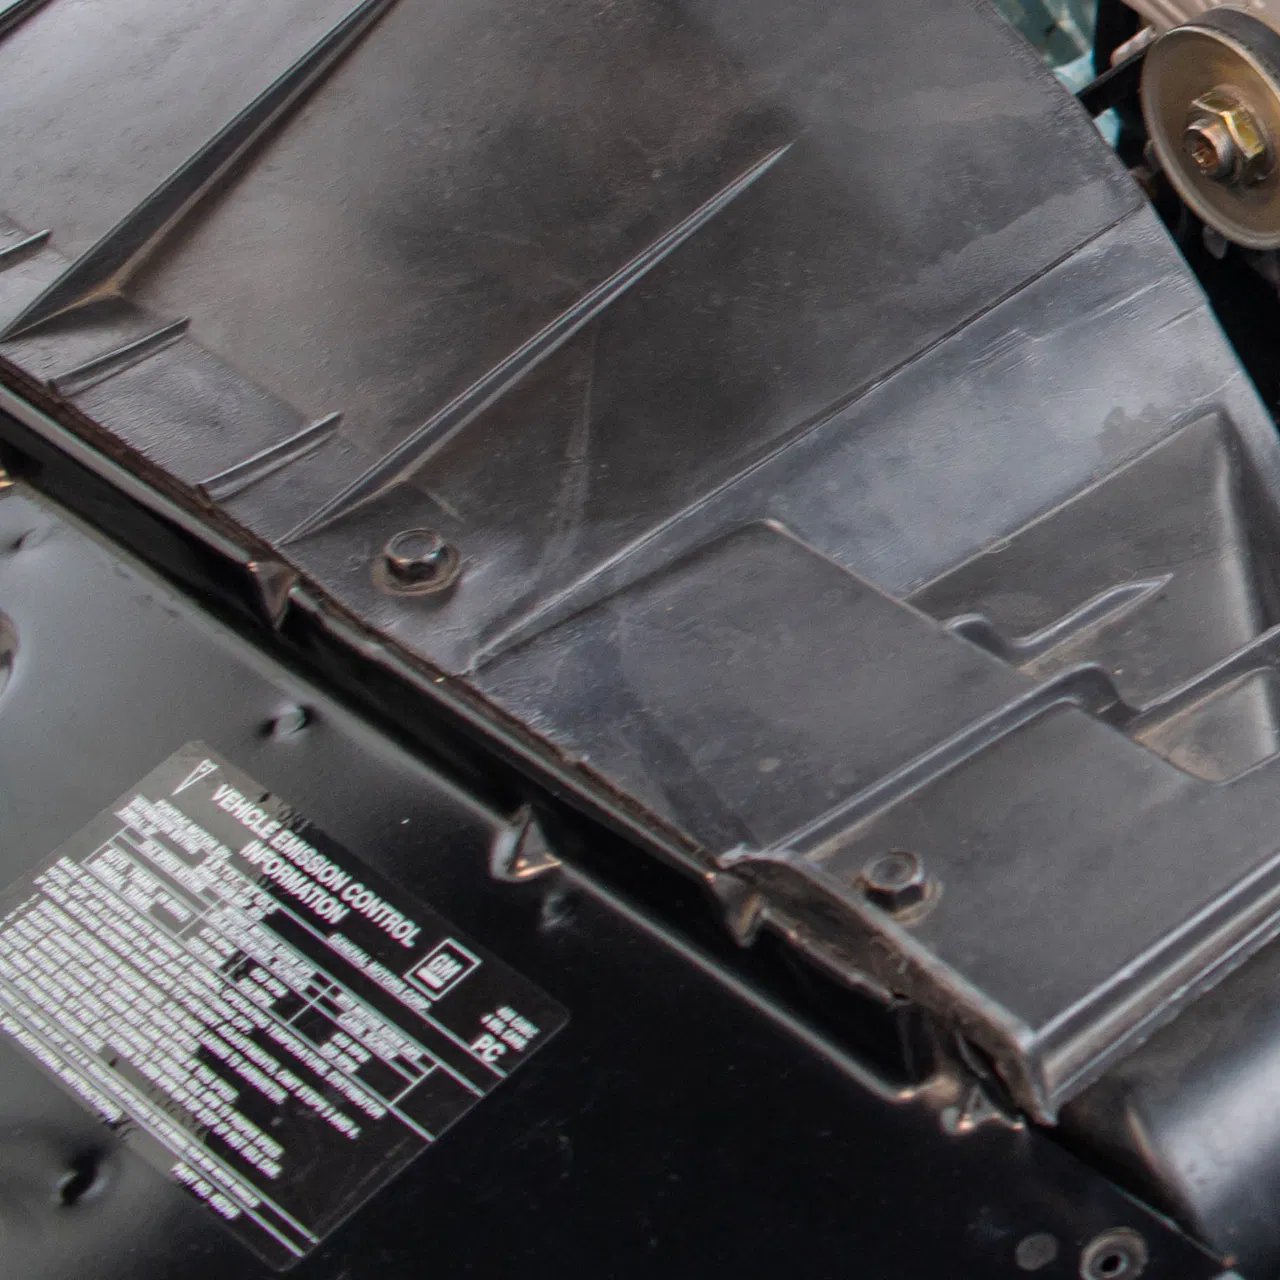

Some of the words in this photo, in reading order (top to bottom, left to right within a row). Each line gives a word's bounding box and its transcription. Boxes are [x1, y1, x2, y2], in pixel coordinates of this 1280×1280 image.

[207, 782, 283, 840] VEHICLE
[268, 827, 352, 893] EMISSION
[337, 880, 427, 949] CONTROL
[237, 838, 351, 925] INFORMATION
[326, 931, 373, 968] GENERAL
[364, 960, 408, 994] MOTORS
[424, 951, 463, 982] GM
[468, 1032, 508, 1065] PC
